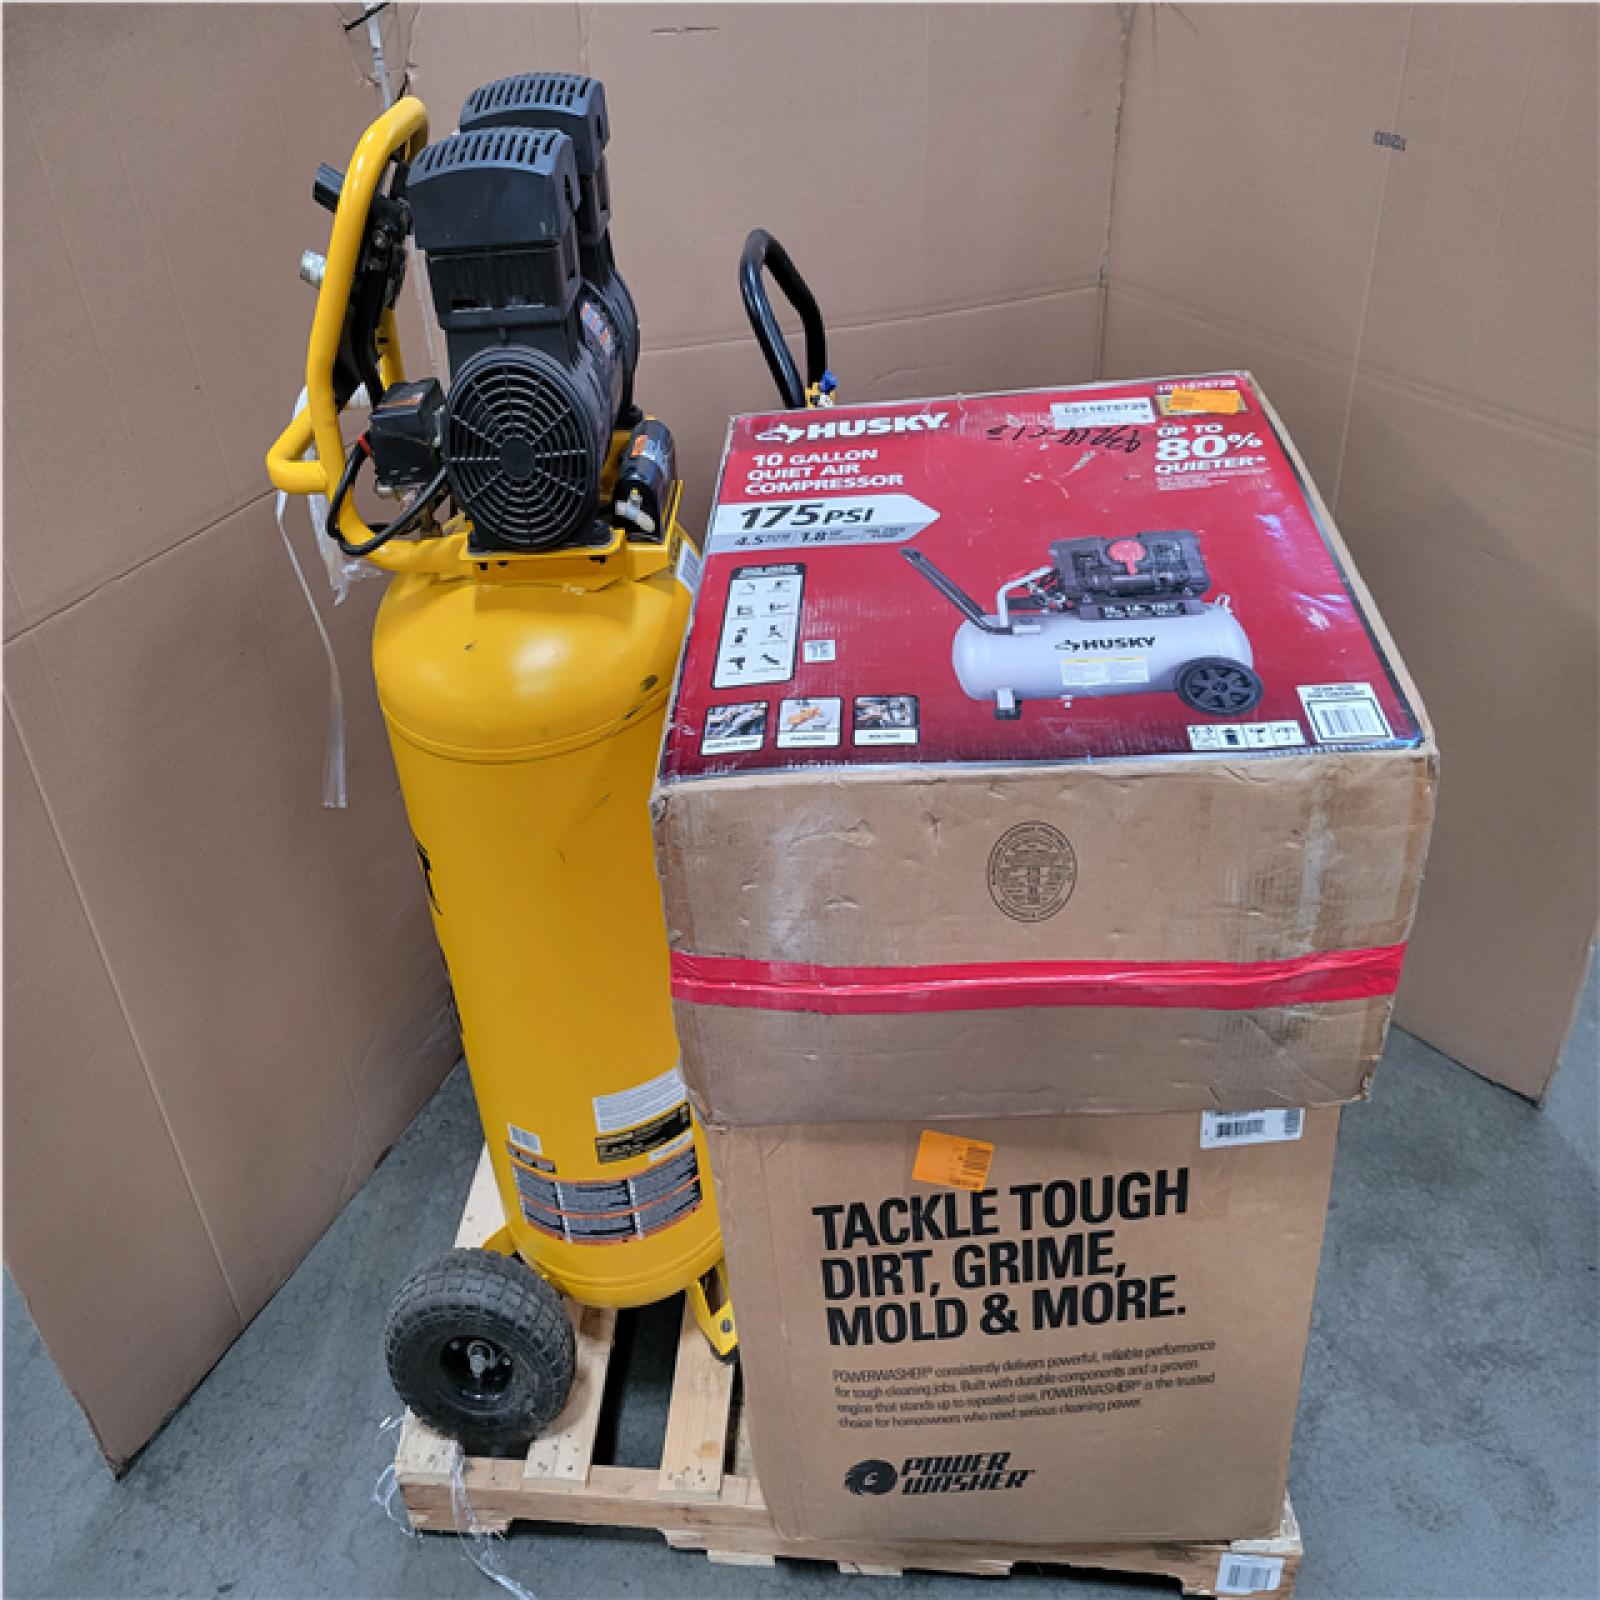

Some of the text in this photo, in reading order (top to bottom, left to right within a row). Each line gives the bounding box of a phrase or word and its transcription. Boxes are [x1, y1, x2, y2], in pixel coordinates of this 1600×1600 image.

[1157, 423, 1223, 436] UP TO
[752, 449, 878, 467] 10 GALLON
[1155, 431, 1263, 461] 80%
[745, 474, 904, 495] COMPRESSOR
[747, 463, 860, 481] QUIET AIR
[740, 503, 875, 530] 175 PSI
[1082, 636, 1155, 650] HUSKY
[812, 1189, 999, 1251] TACKLE
[1009, 1167, 1189, 1231] TOUGH
[820, 1229, 1126, 1301] DIRT, GRIME,
[825, 1274, 1187, 1347] MOLD & MORE.
[1144, 1340, 1216, 1360] performance
[834, 1385, 851, 1398] for
[853, 1385, 883, 1400] tough
[885, 1383, 931, 1397] cleaning
[987, 1377, 1013, 1390] with
[1056, 1366, 1126, 1382] components
[1127, 1362, 1148, 1376] and
[1159, 1359, 1198, 1375] proven
[837, 1403, 873, 1416] engine
[874, 1401, 897, 1413] that
[899, 1399, 935, 1411] stands
[937, 1399, 950, 1411] up
[952, 1398, 965, 1408] to
[966, 1392, 1016, 1408] repeated
[1154, 1376, 1173, 1389] the
[1176, 1372, 1215, 1387] trusted
[839, 1417, 873, 1429] choice
[874, 1416, 891, 1428] for
[892, 1413, 961, 1427] homeowners
[962, 1411, 988, 1423] who
[989, 1408, 1015, 1420] need
[1018, 1406, 1057, 1418] serious
[1059, 1400, 1105, 1414] cleaning
[901, 1451, 1011, 1476] POWER
[902, 1469, 1032, 1496] WASHER
